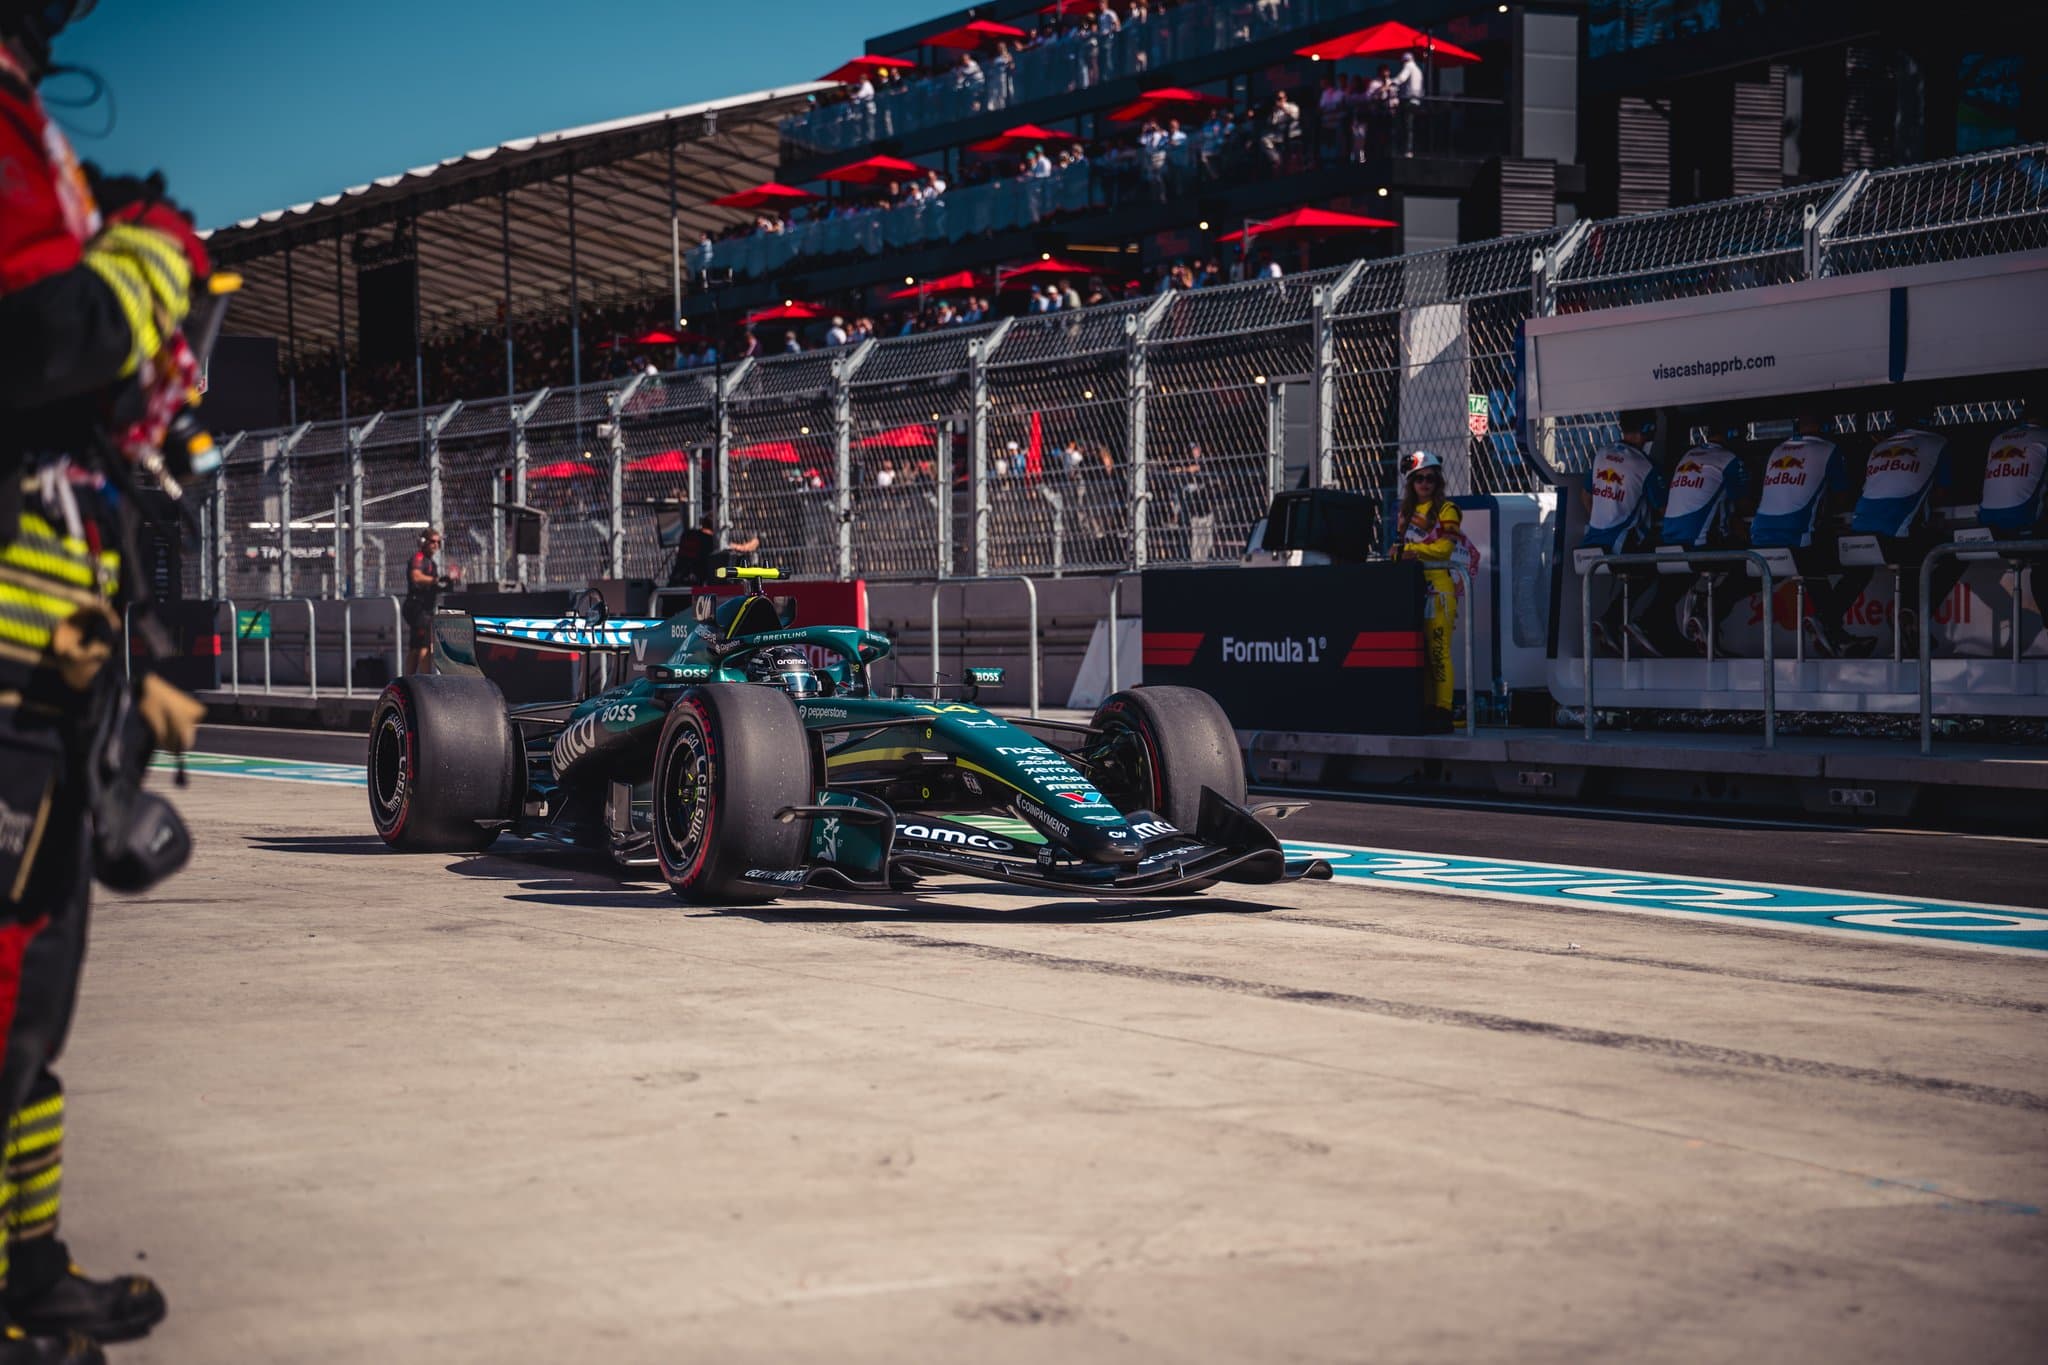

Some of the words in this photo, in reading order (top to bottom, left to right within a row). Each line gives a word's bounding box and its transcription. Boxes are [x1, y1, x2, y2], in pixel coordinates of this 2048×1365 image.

[1653, 355, 1776, 380] visacashapprb.com
[1892, 459, 1920, 473] Bull
[1985, 465, 2001, 479] ed
[2002, 463, 2029, 477] Bull
[1934, 583, 1971, 624] ull
[671, 624, 688, 638] BOSS
[762, 631, 807, 641] BREITLING
[1222, 637, 1303, 662] Formula
[674, 668, 708, 678] BOSS
[976, 672, 999, 682] BOSS
[602, 705, 637, 722] BOSS
[808, 706, 847, 719] pepperstone
[1021, 800, 1071, 838] COINPAYMENTS
